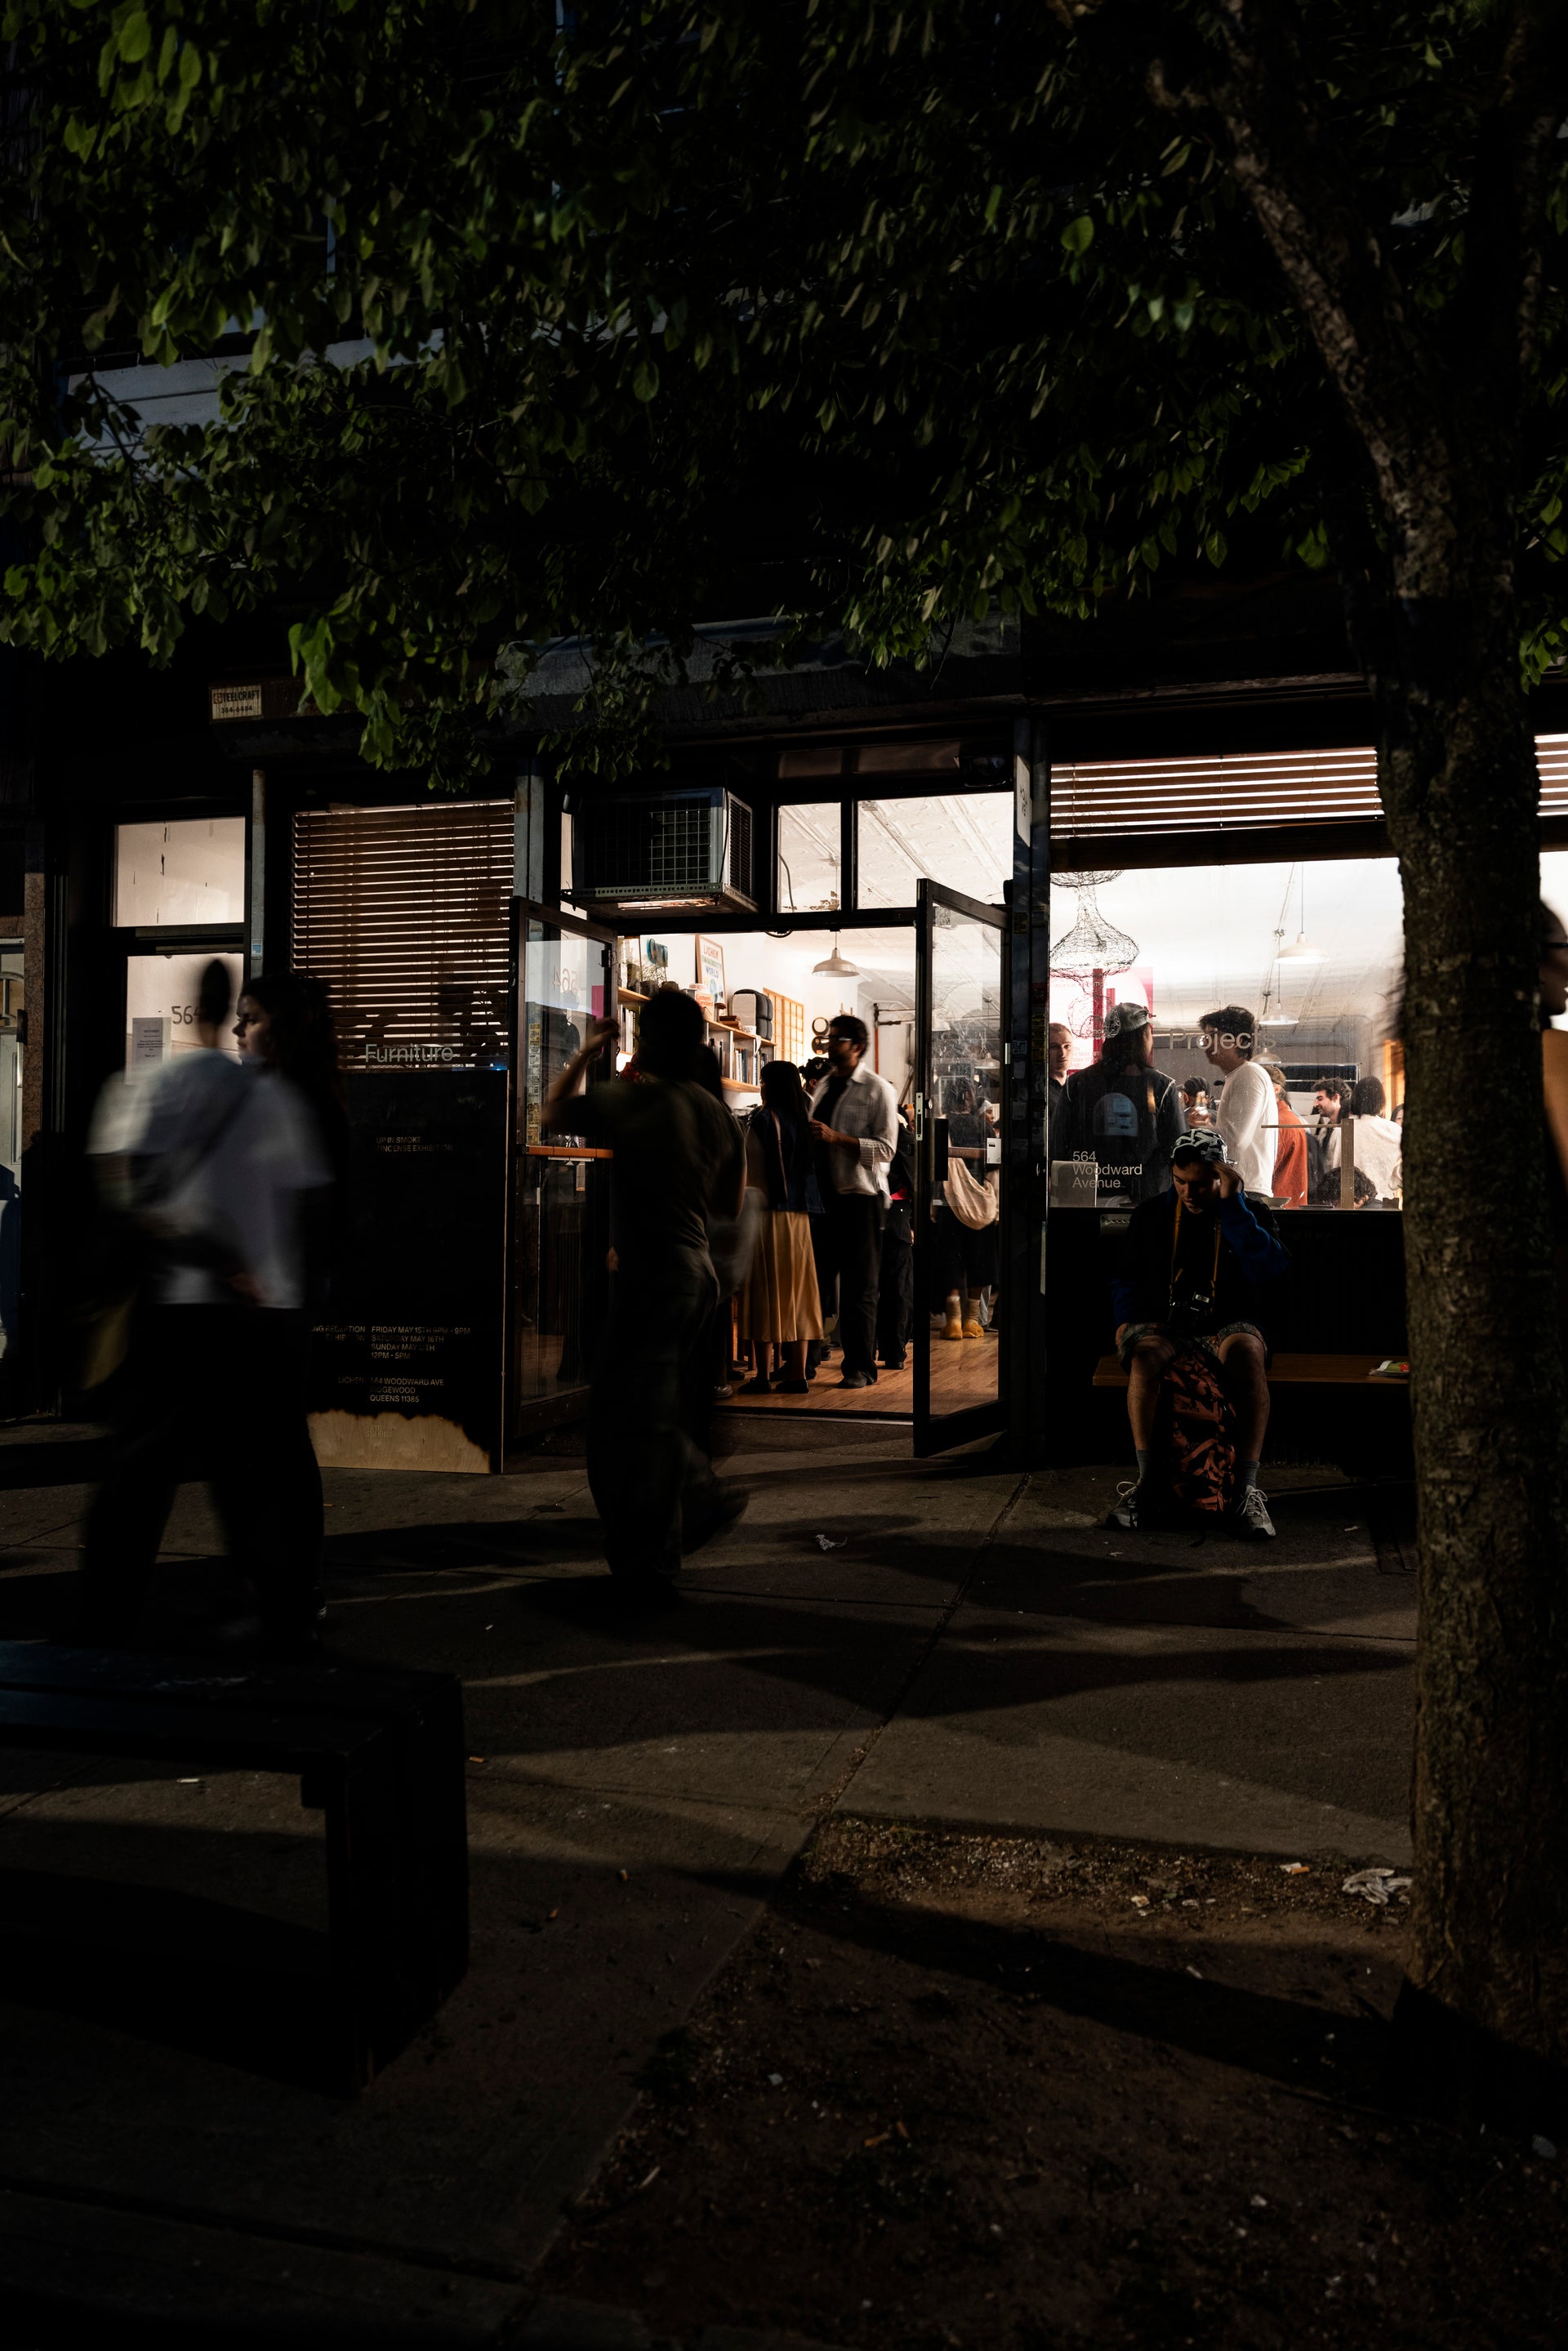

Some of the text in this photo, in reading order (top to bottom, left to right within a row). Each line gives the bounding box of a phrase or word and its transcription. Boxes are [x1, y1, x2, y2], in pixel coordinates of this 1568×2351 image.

[213, 690, 260, 704] STEELCRAFT
[1169, 1028, 1276, 1055] Projects
[365, 1042, 453, 1063] Furniture
[395, 1136, 422, 1144] SMOKE
[1072, 1150, 1097, 1162] 564
[1072, 1163, 1143, 1176] Woodward
[1072, 1176, 1121, 1189] Avenue
[454, 1327, 471, 1335] 9PM
[384, 1377, 430, 1385] WOODWARD
[369, 1394, 420, 1403] QUEENS 11385
